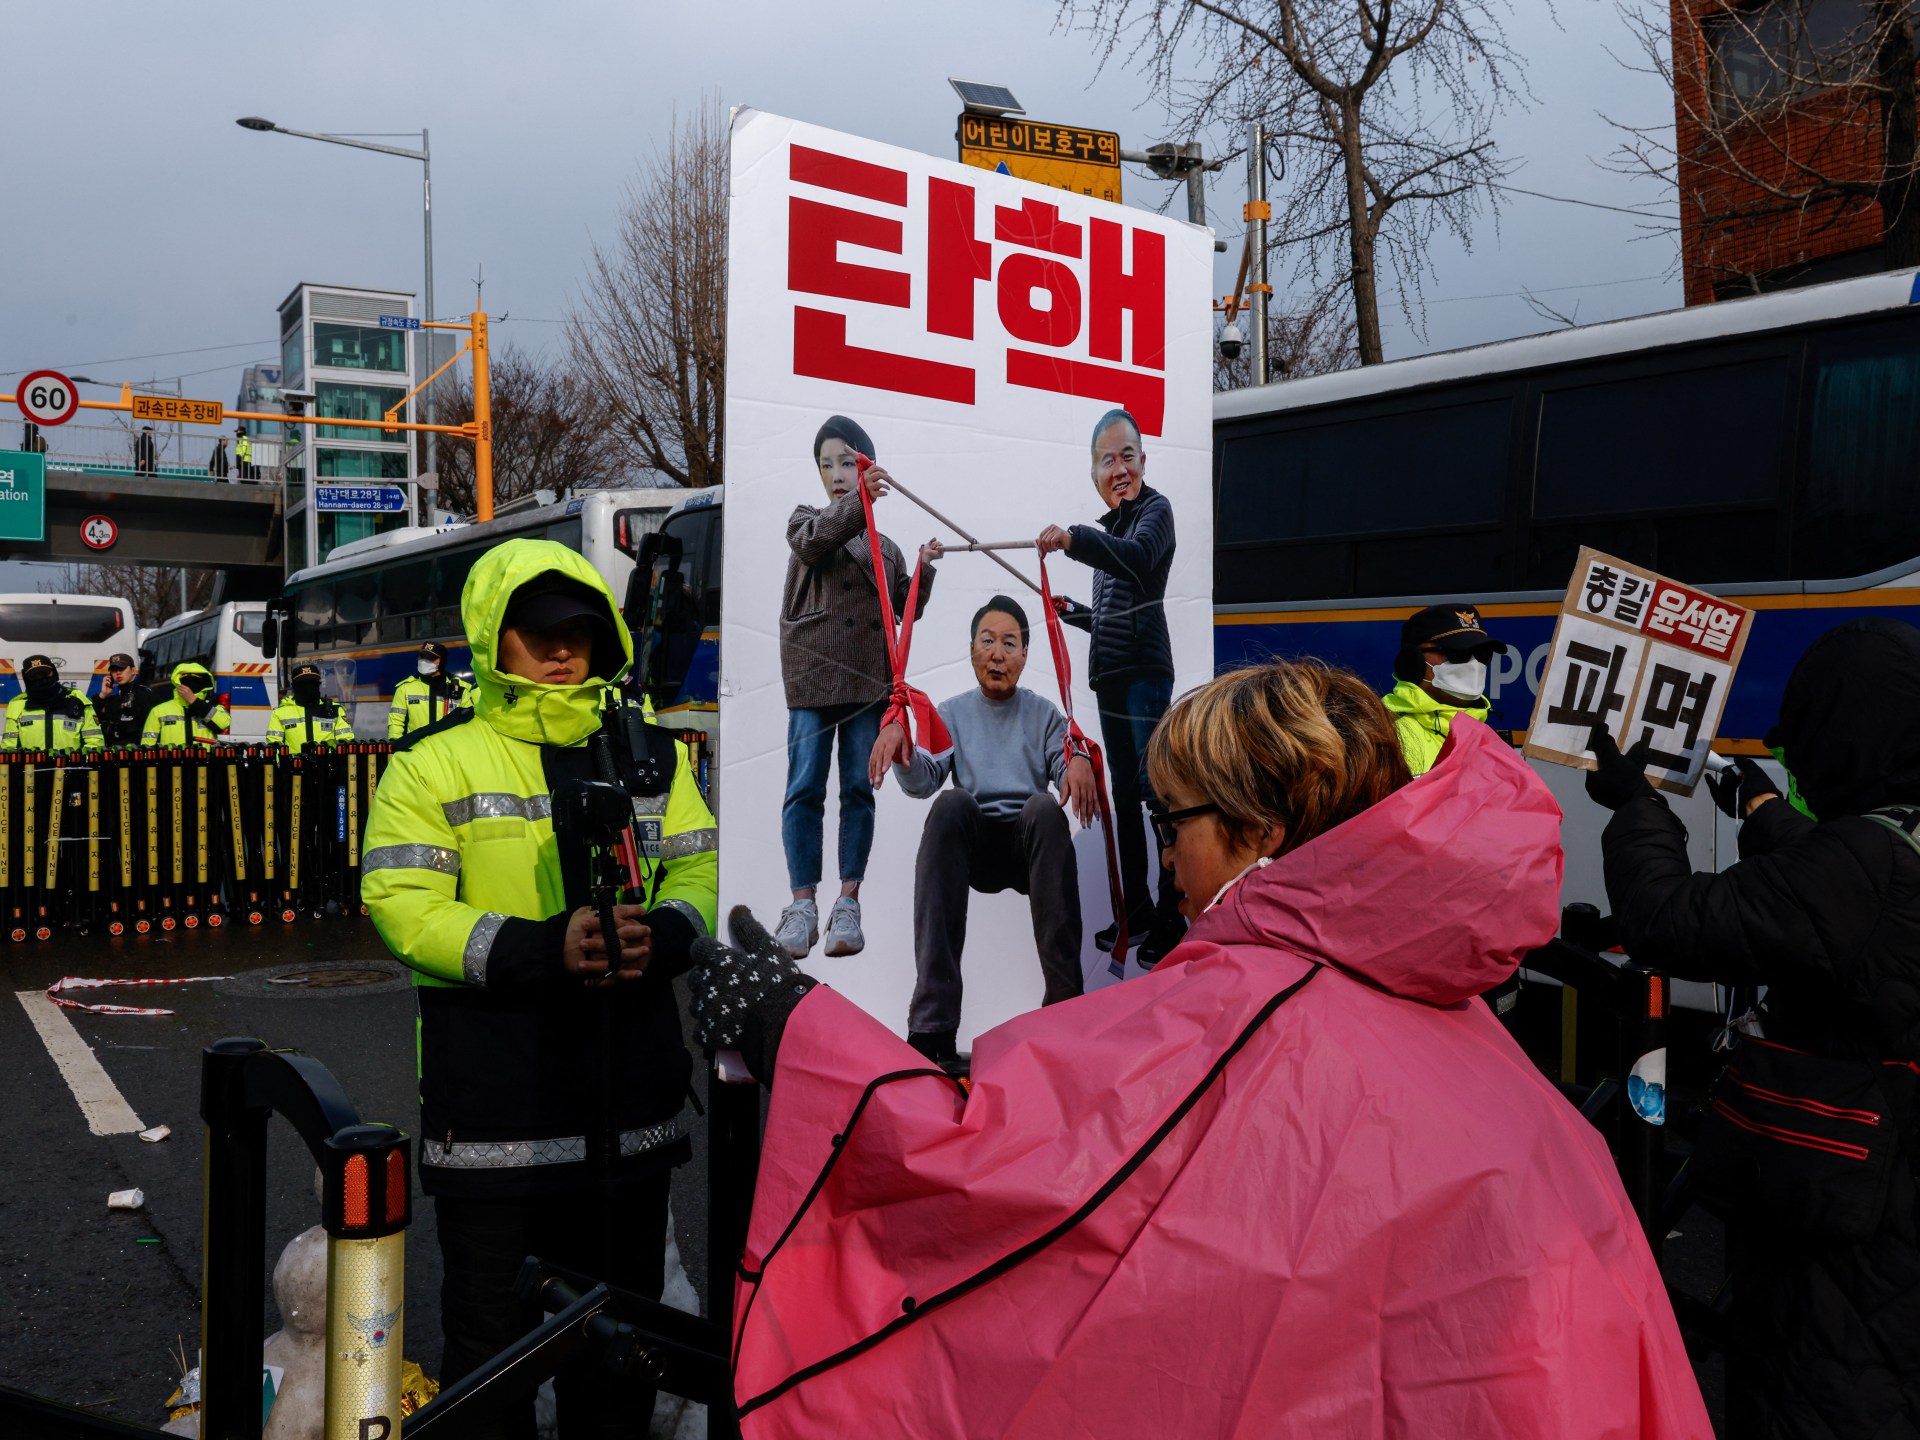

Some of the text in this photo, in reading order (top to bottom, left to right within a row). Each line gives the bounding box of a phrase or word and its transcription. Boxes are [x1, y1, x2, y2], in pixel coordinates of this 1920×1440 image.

[966, 119, 1115, 163] 어린이보호구역
[787, 142, 1165, 438] 탄핵
[30, 386, 66, 411] 60
[137, 399, 218, 421] 과속단속장비
[318, 488, 381, 501] 한남대로28길
[318, 501, 393, 510] Hannam-daero 28-gil
[1586, 566, 1741, 653] 총칼 윤석열
[1547, 640, 1717, 774] 파면
[644, 822, 659, 840] 찰
